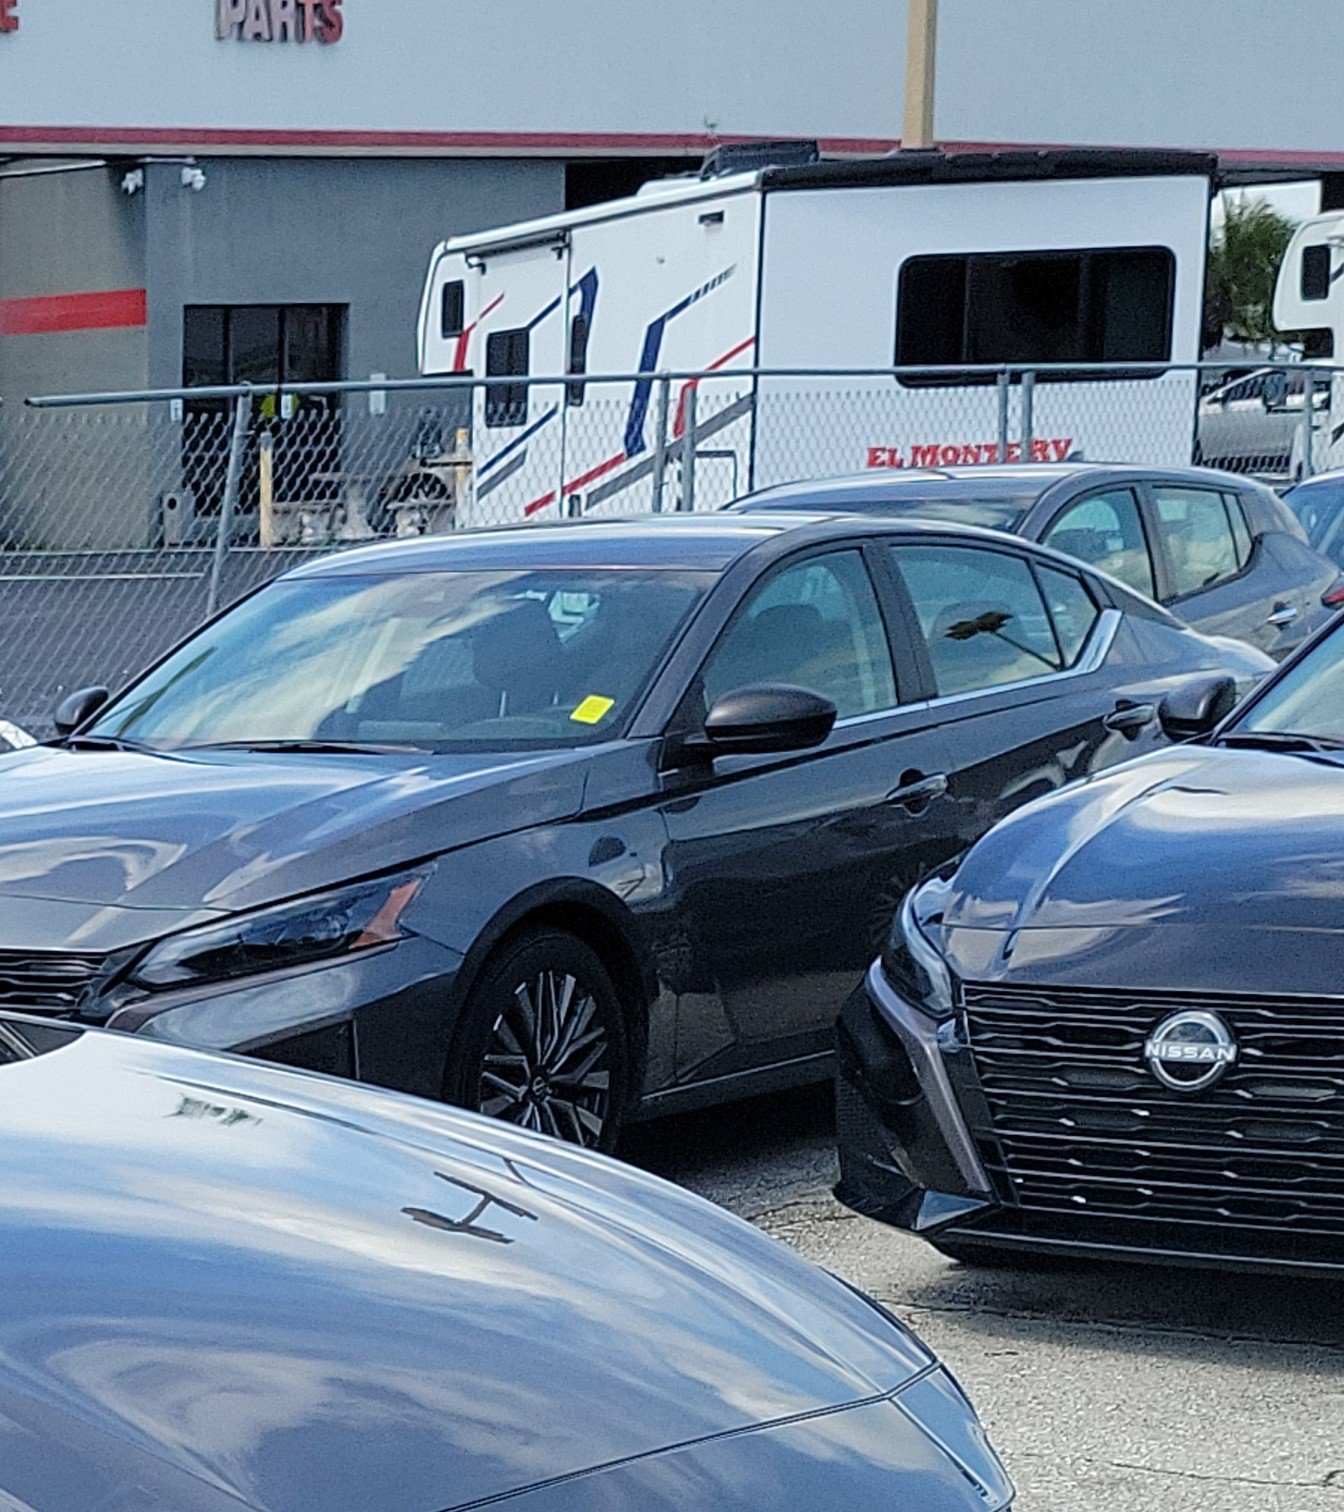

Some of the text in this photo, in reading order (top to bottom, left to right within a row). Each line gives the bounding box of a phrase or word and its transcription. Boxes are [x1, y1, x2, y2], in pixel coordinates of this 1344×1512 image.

[215, 0, 343, 45] PARTS
[867, 438, 1072, 468] EL MONTE RV
[1145, 1041, 1236, 1061] NISSAN
